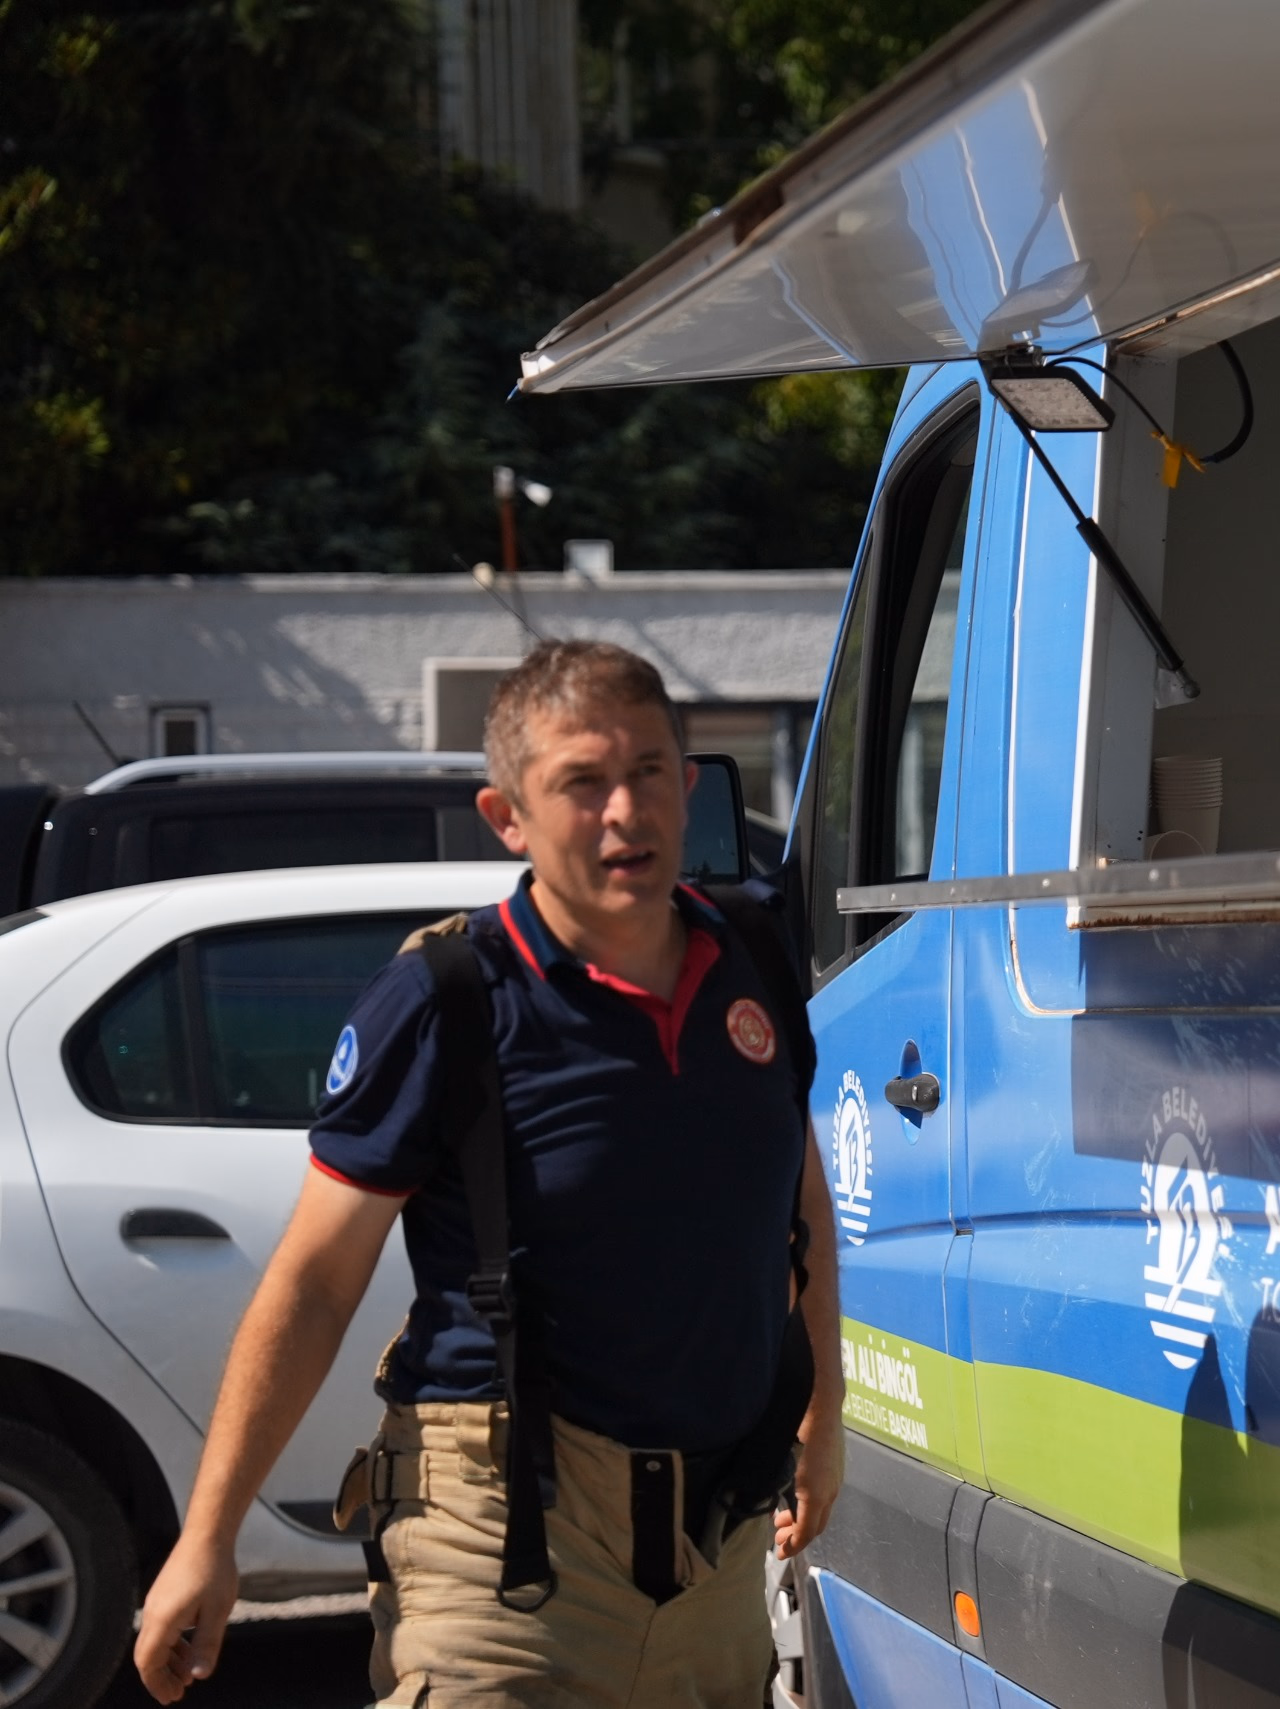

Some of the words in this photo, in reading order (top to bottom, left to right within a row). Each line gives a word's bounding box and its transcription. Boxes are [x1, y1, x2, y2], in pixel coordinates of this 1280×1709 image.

[857, 1333, 878, 1391] ALİ
[876, 1338, 924, 1410] BİNGÖL
[887, 1408, 929, 1450] BAŞKANI
